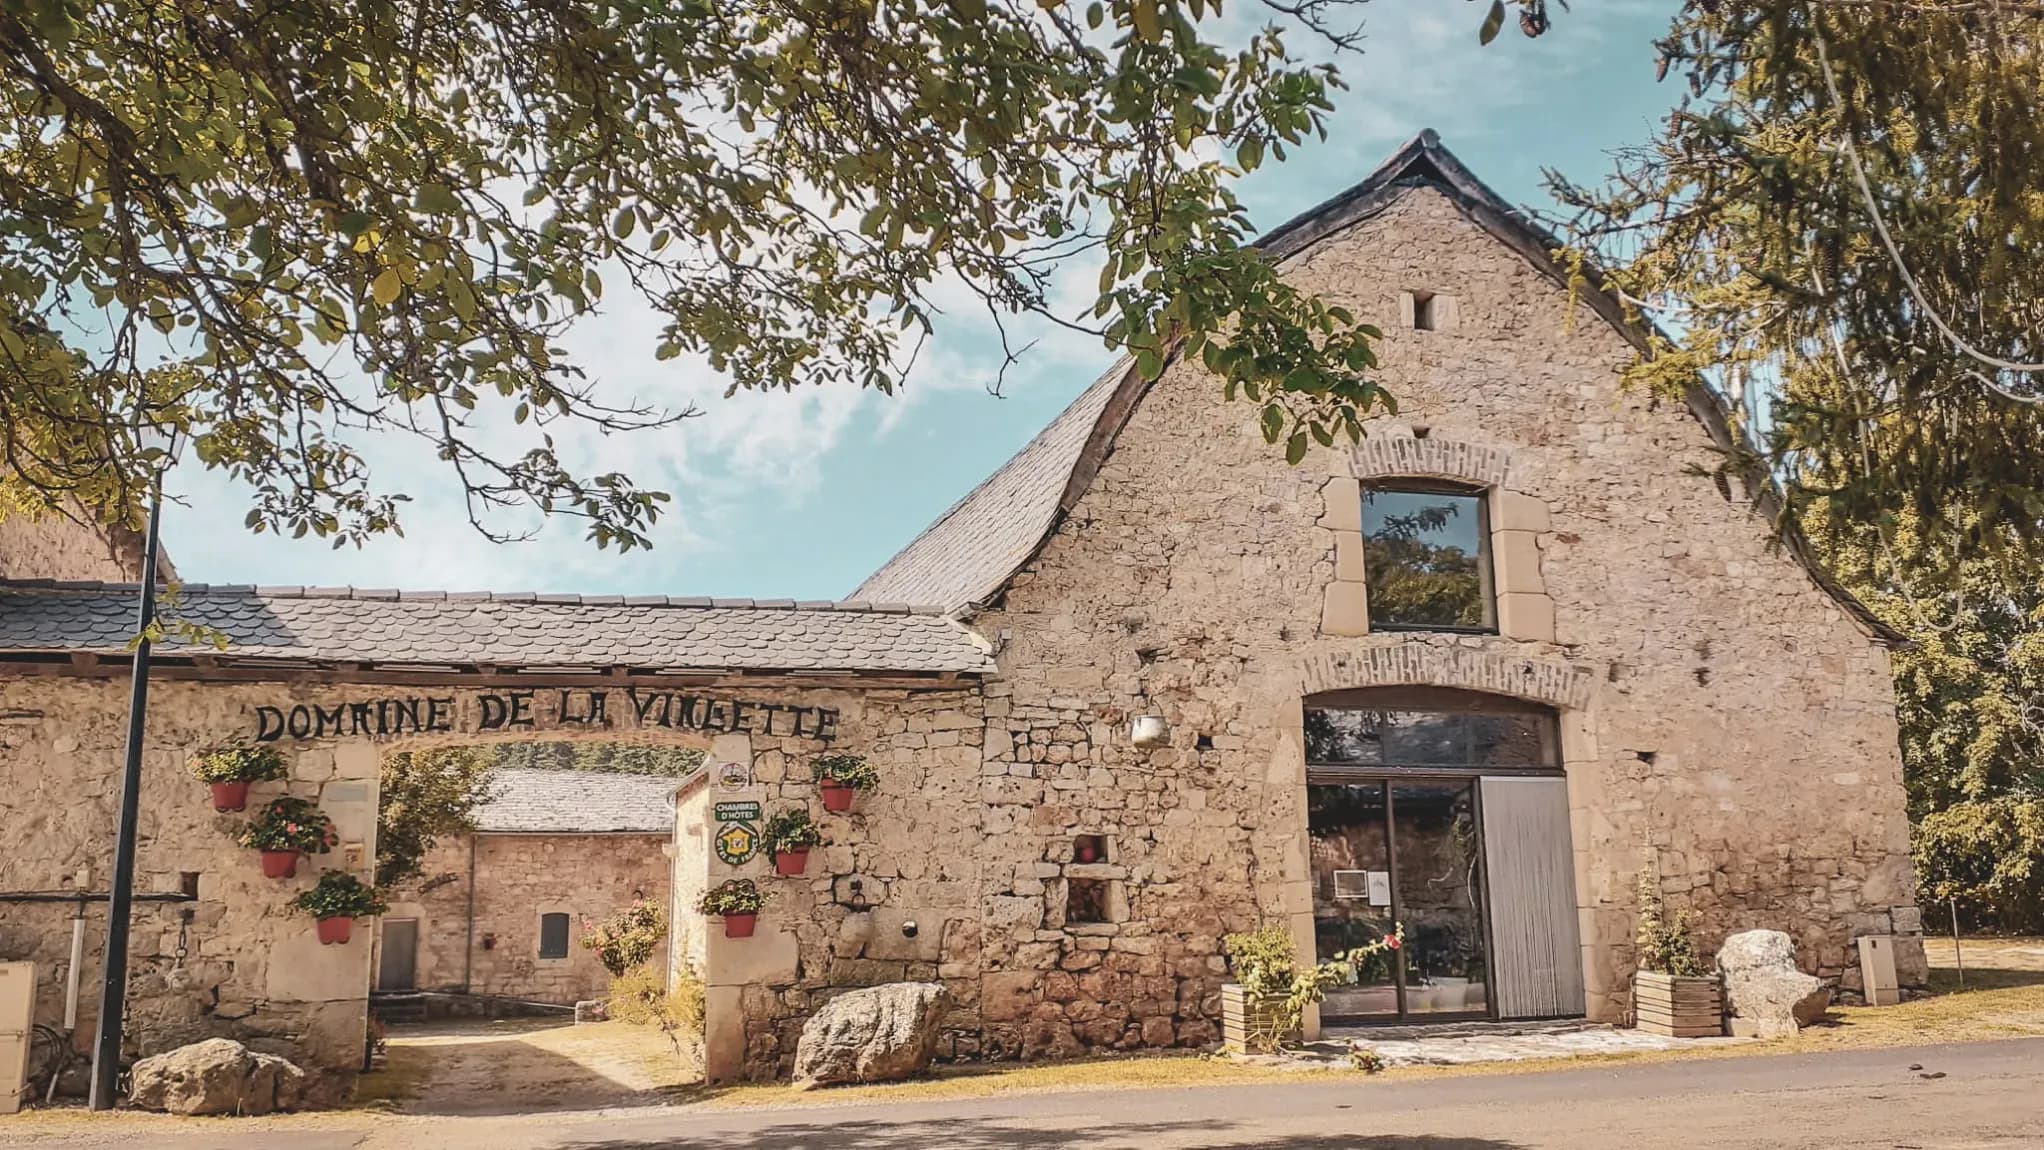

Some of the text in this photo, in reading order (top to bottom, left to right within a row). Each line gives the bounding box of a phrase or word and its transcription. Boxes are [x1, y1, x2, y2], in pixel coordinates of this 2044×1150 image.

[255, 697, 457, 742] DOMAINE
[477, 692, 535, 730] DE
[558, 690, 609, 724] LA
[716, 803, 758, 812] CHAMBRES
